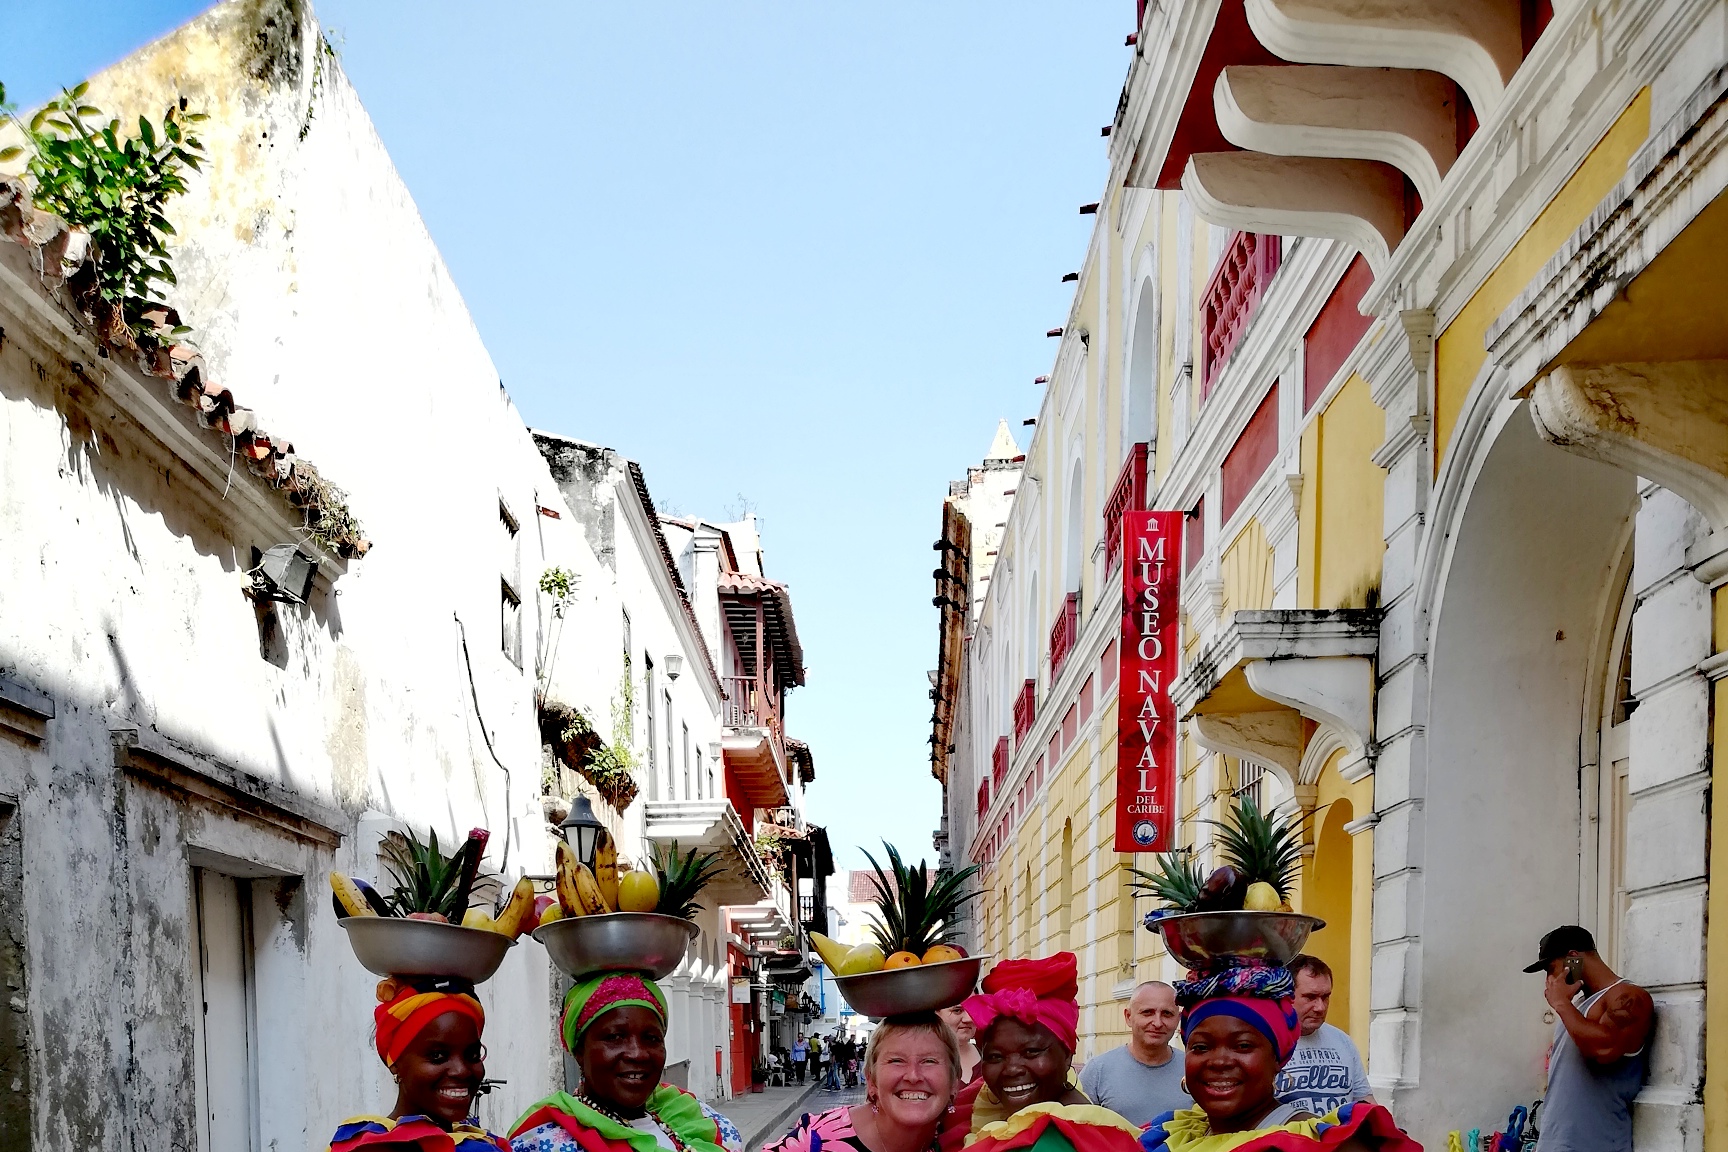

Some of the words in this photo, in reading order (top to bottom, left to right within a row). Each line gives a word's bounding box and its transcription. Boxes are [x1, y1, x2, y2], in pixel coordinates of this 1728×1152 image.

[1137, 537, 1167, 661] MUSEO
[1135, 669, 1163, 793] NAVAL
[1127, 804, 1165, 814] CARIBE
[1136, 795, 1158, 804] DEL
